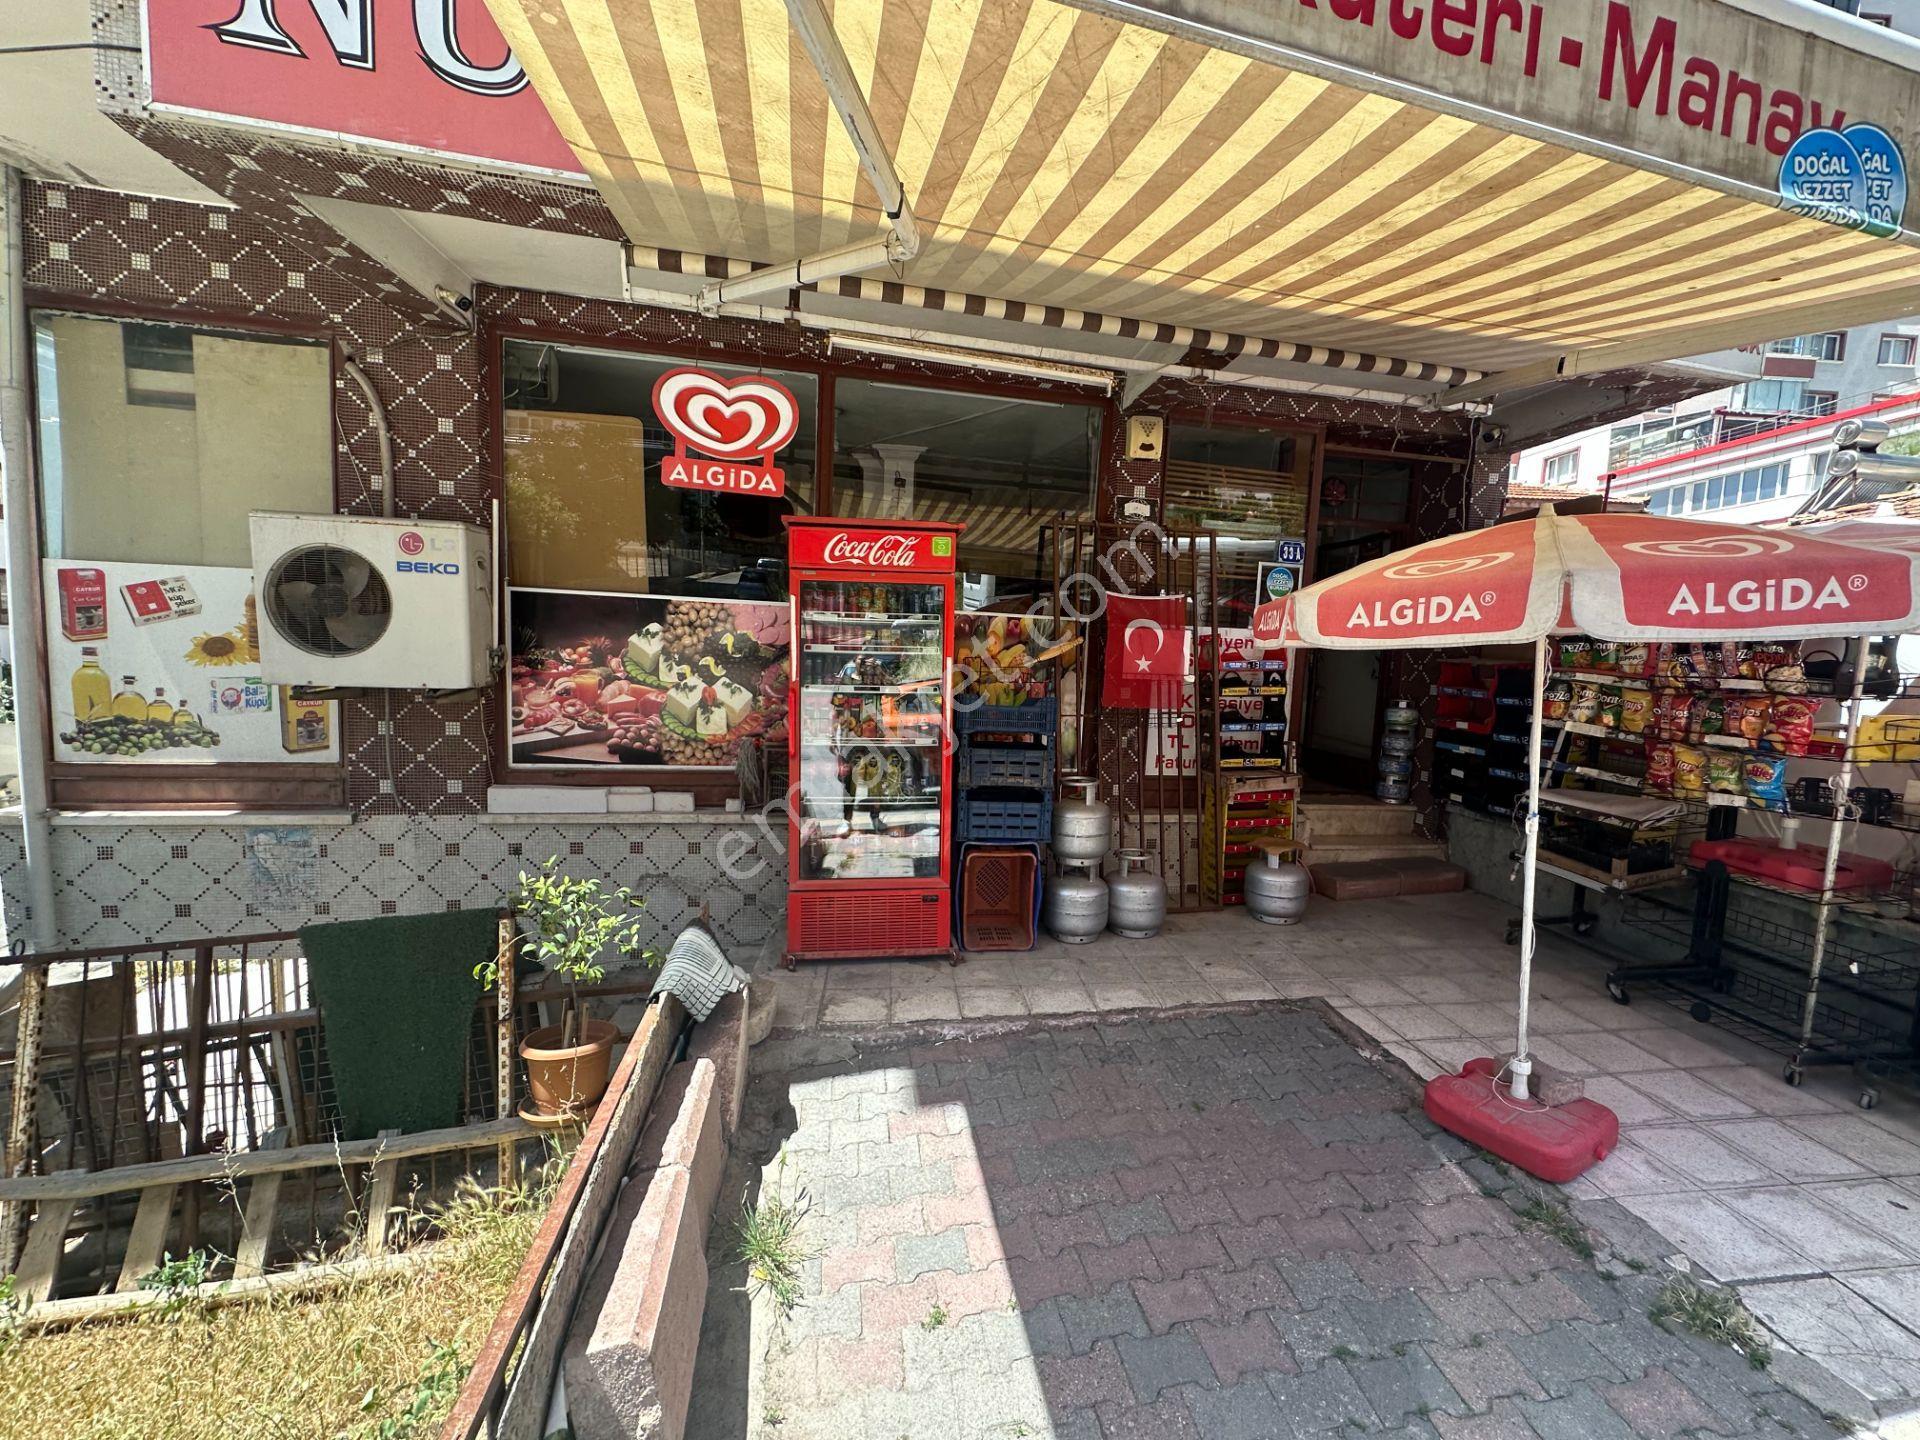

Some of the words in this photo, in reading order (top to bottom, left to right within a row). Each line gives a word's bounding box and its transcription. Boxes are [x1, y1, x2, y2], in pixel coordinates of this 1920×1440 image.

[1793, 151, 1851, 175] DOĞAL
[1793, 182, 1853, 200] LEZZET
[823, 532, 921, 567] Coca-Cola
[396, 561, 460, 575] BEKO
[244, 686, 258, 697] Bal
[245, 696, 268, 709] Küpü
